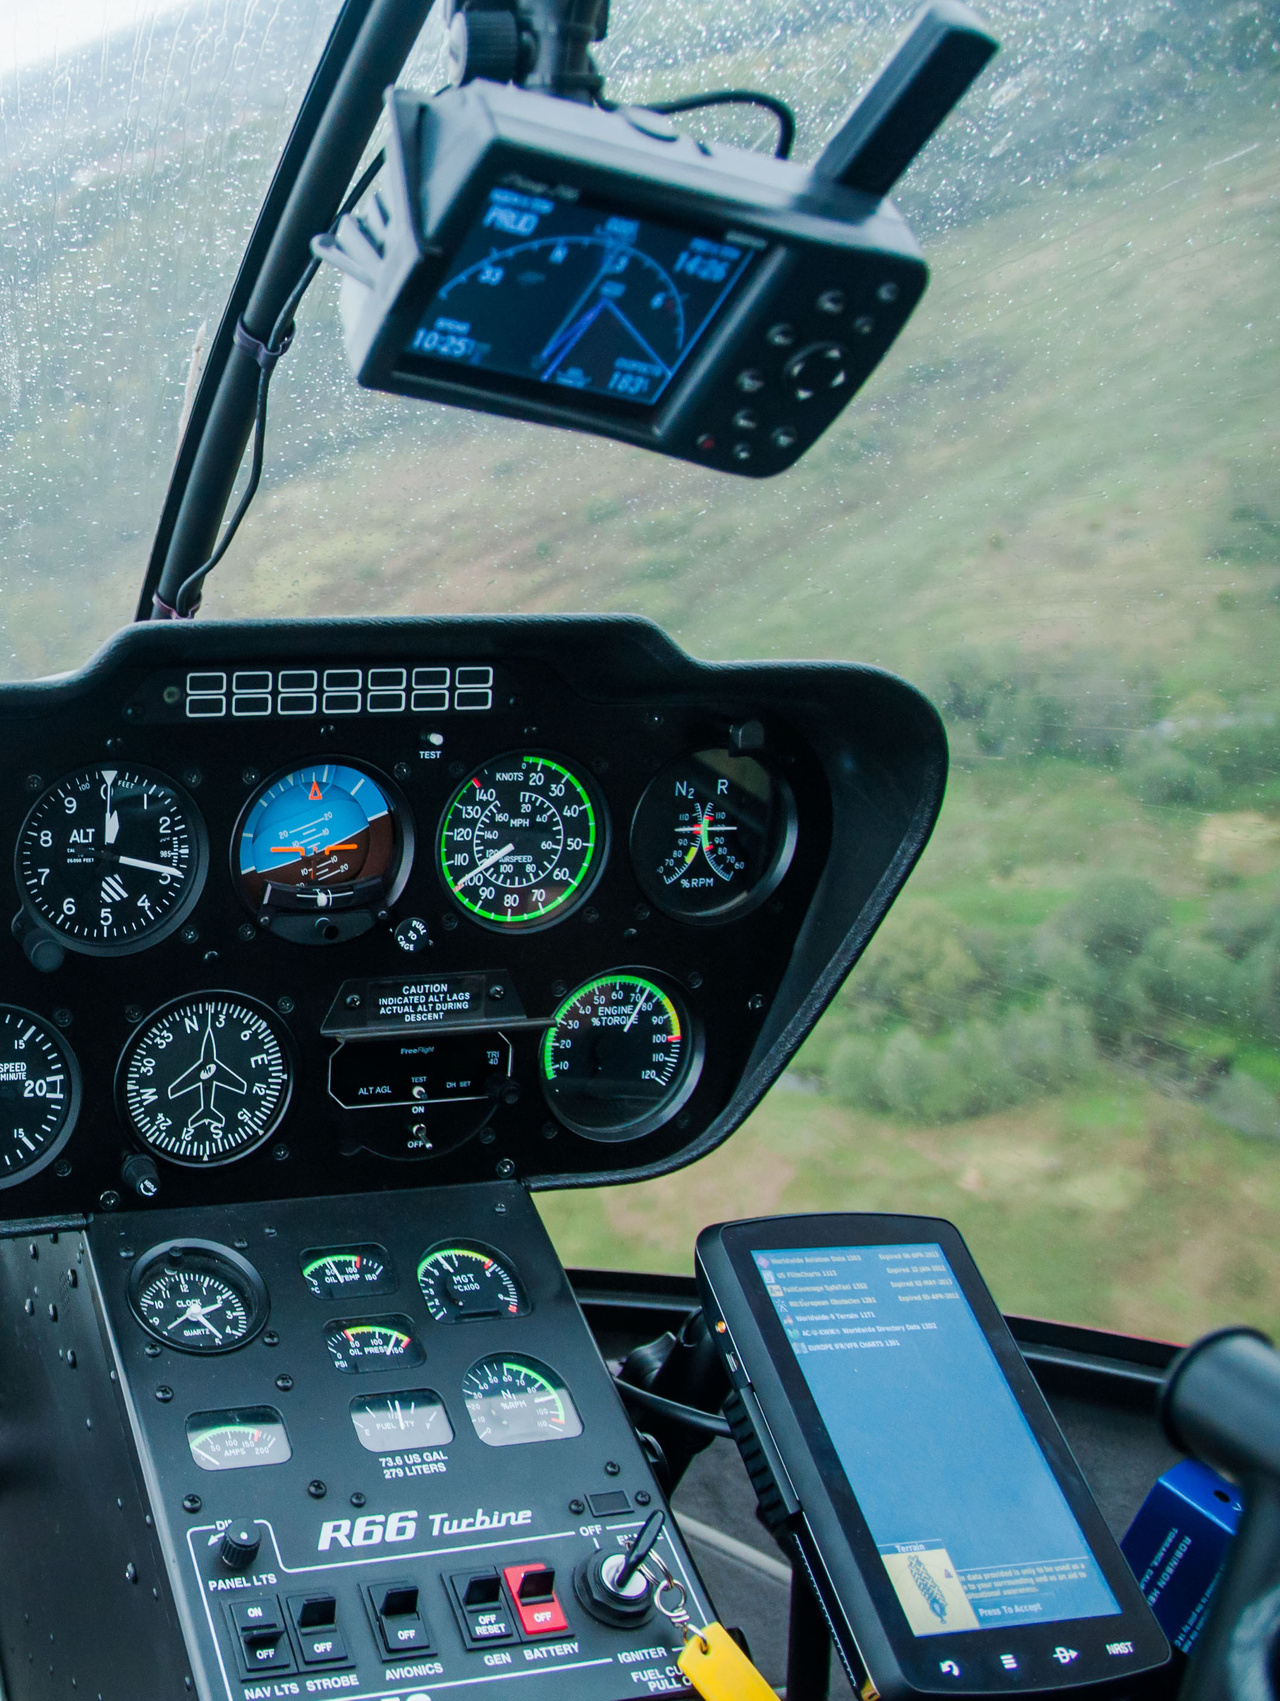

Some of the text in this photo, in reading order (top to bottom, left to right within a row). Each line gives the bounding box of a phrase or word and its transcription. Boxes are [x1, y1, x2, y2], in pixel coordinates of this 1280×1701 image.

[419, 751, 441, 759] TEST
[496, 772, 524, 781] KNOTS
[529, 772, 544, 786] 20
[118, 780, 135, 789] FEET
[549, 784, 565, 797] 30
[717, 779, 728, 794] R
[476, 788, 496, 801] 140
[64, 797, 77, 814] 9
[521, 804, 532, 813] 20
[563, 805, 579, 818] 40
[324, 811, 333, 821] 20
[462, 806, 481, 819] 130
[495, 813, 509, 822] 160
[159, 816, 171, 833] 2
[510, 819, 529, 827] MPH
[40, 830, 52, 847] 8
[70, 829, 95, 843] ALT
[279, 830, 289, 840] 20
[454, 828, 472, 841] 120
[541, 841, 552, 850] 60
[567, 838, 582, 850] 50
[714, 837, 724, 845] 90
[454, 853, 469, 866] 110
[726, 856, 735, 864] 70
[339, 863, 349, 874] 20
[500, 864, 513, 873] 100
[525, 864, 537, 873] 80
[553, 868, 569, 881] 60
[38, 868, 50, 886] 7
[479, 887, 495, 900] 90
[531, 889, 546, 902] 70
[63, 898, 76, 915] 6
[137, 894, 151, 911] 4
[504, 894, 519, 907] 80
[100, 908, 113, 926] 5
[412, 920, 427, 935] PULL
[408, 930, 417, 941] TO
[397, 935, 415, 951] CAGE
[402, 983, 448, 995] CAUTION
[379, 992, 470, 1006] INDICATED ALT LAGS
[593, 996, 606, 1005] 50
[611, 991, 624, 1000] 60
[380, 1001, 469, 1015] ACTUAL ALT DURING
[578, 1006, 591, 1015] 40
[598, 1005, 634, 1016] ENGINE
[641, 1002, 653, 1011] 80
[216, 1014, 225, 1028] 3
[405, 1012, 444, 1023] DESCENT
[651, 1016, 664, 1025] 90
[184, 1015, 199, 1034] N
[154, 1030, 173, 1049] 33
[241, 1030, 252, 1041] 6
[652, 1034, 667, 1043] 100
[14, 1040, 25, 1049] 15
[560, 1040, 572, 1049] 20
[250, 1053, 269, 1068] E
[488, 1058, 499, 1066] 40
[652, 1053, 664, 1062] 110
[140, 1058, 156, 1076] 30
[560, 1061, 569, 1070] 10
[0, 1072, 27, 1081] MINUTE
[641, 1070, 656, 1079] 120
[23, 1080, 47, 1097] 20
[253, 1083, 266, 1096] 12
[358, 1086, 392, 1095] ALT AGL
[446, 1080, 471, 1089] DH SET
[139, 1088, 158, 1105] W
[237, 1108, 252, 1122] 15
[411, 1106, 425, 1114] ON
[156, 1112, 172, 1130] 24
[14, 1129, 25, 1138] 15
[182, 1127, 194, 1141] 21
[210, 1123, 223, 1139] S
[407, 1141, 424, 1149] OFF
[452, 1273, 475, 1285] MGT
[180, 1284, 189, 1293] 12
[155, 1300, 164, 1309] 10
[176, 1299, 202, 1308] CLOCK
[836, 1311, 859, 1320] Terrain
[183, 1328, 210, 1337] QUARTZ
[842, 1326, 875, 1335] Worldwide
[877, 1324, 905, 1333] Directory
[808, 1340, 884, 1351] EUROPE CHARTS
[334, 1361, 348, 1369] PSI
[376, 1422, 397, 1430] FUEL
[224, 1447, 246, 1457] AMPS
[379, 1450, 448, 1467] 73.6 US GAL
[384, 1462, 447, 1479] 279 LITERS
[317, 1508, 532, 1551] R66 Turbine
[579, 1524, 603, 1538] OFF
[895, 1543, 925, 1553] Terrain
[1159, 1535, 1191, 1591] ROBINSON
[208, 1573, 277, 1591] PANEL LTS
[247, 1606, 263, 1618] ON
[978, 1601, 1042, 1617] Press To Accept
[478, 1614, 497, 1625] OFF
[533, 1611, 552, 1622] OFF
[397, 1629, 416, 1641] OFF
[476, 1623, 506, 1635] RESET
[313, 1641, 333, 1653] OFF
[523, 1642, 580, 1661] BATTERY
[1105, 1641, 1133, 1655] NRST
[256, 1648, 275, 1660] OFF
[483, 1653, 512, 1666] GEN
[617, 1647, 668, 1664] IGNITER
[385, 1662, 444, 1681] AVIONICS
[631, 1669, 664, 1683] FUEL
[306, 1674, 360, 1692] STROBE
[648, 1679, 680, 1692] PULL
[244, 1683, 300, 1701] NAV LTS
